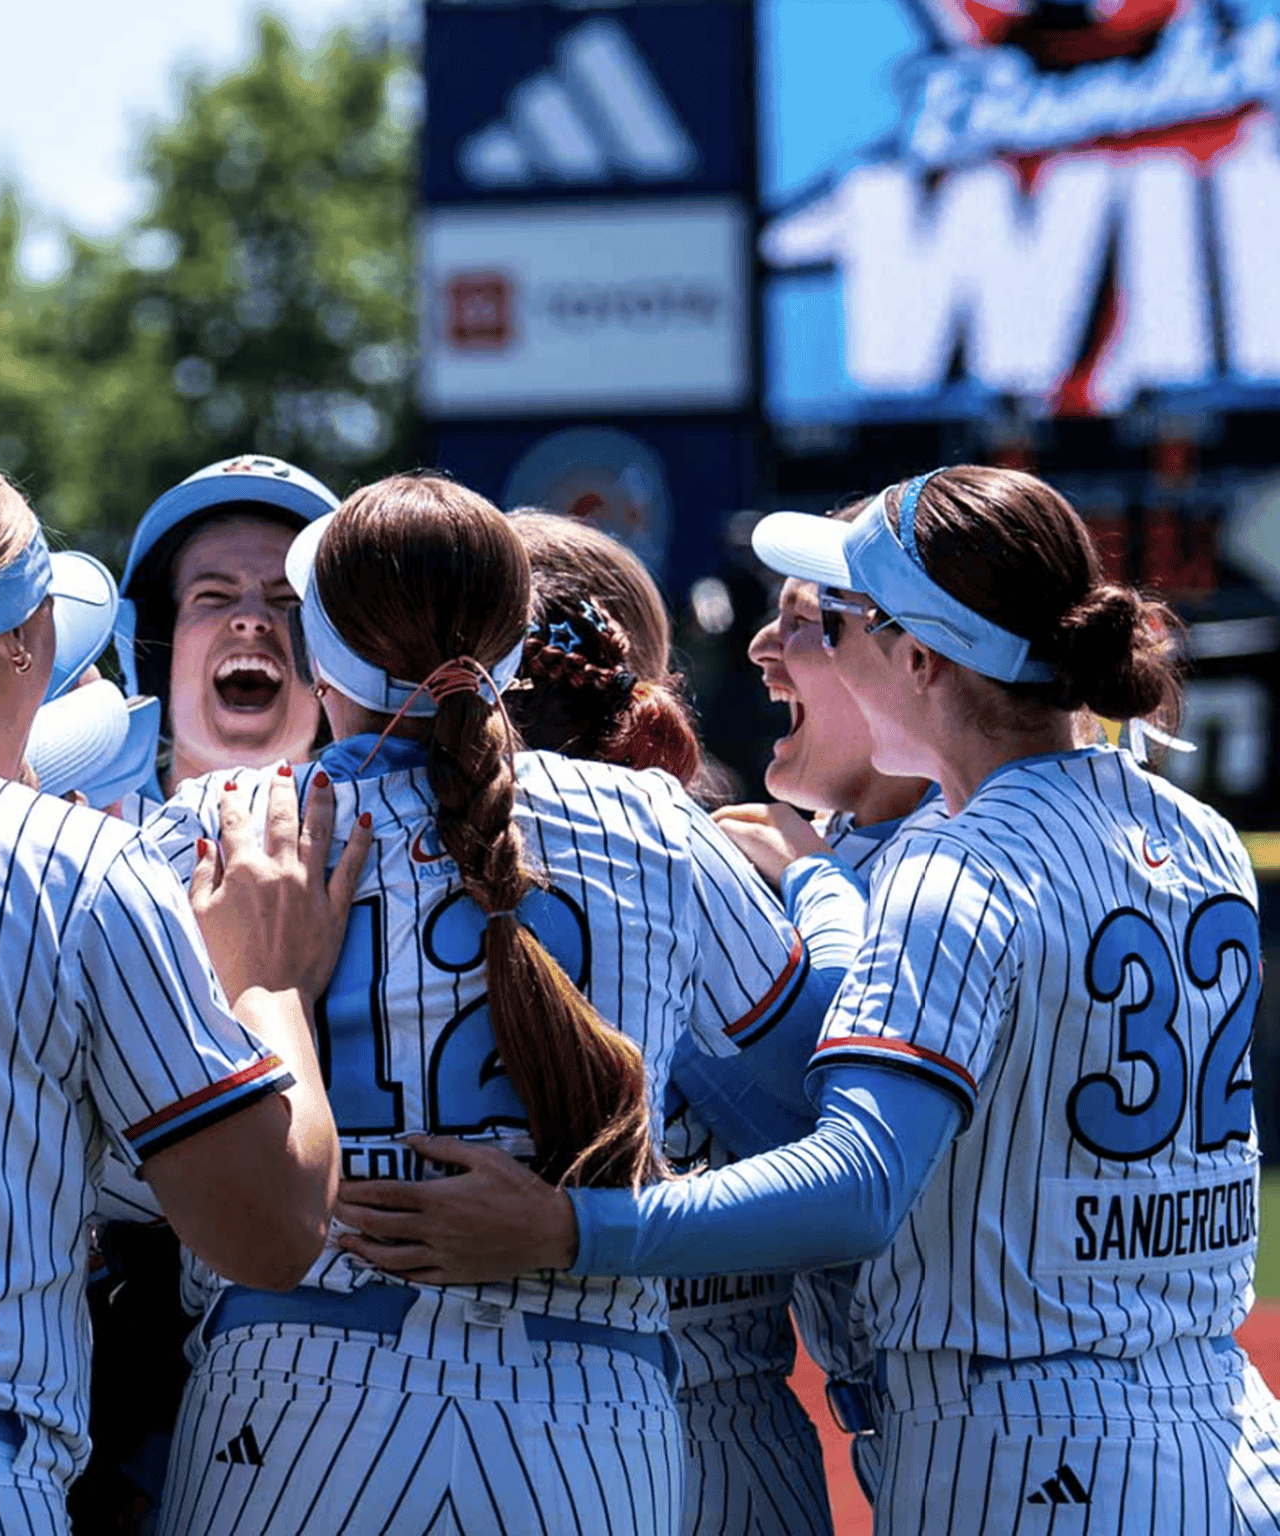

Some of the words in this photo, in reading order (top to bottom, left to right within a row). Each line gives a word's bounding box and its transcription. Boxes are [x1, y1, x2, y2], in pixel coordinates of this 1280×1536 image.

[419, 859, 458, 879] AUS
[314, 883, 592, 1137] 12
[1067, 893, 1262, 1162] 32
